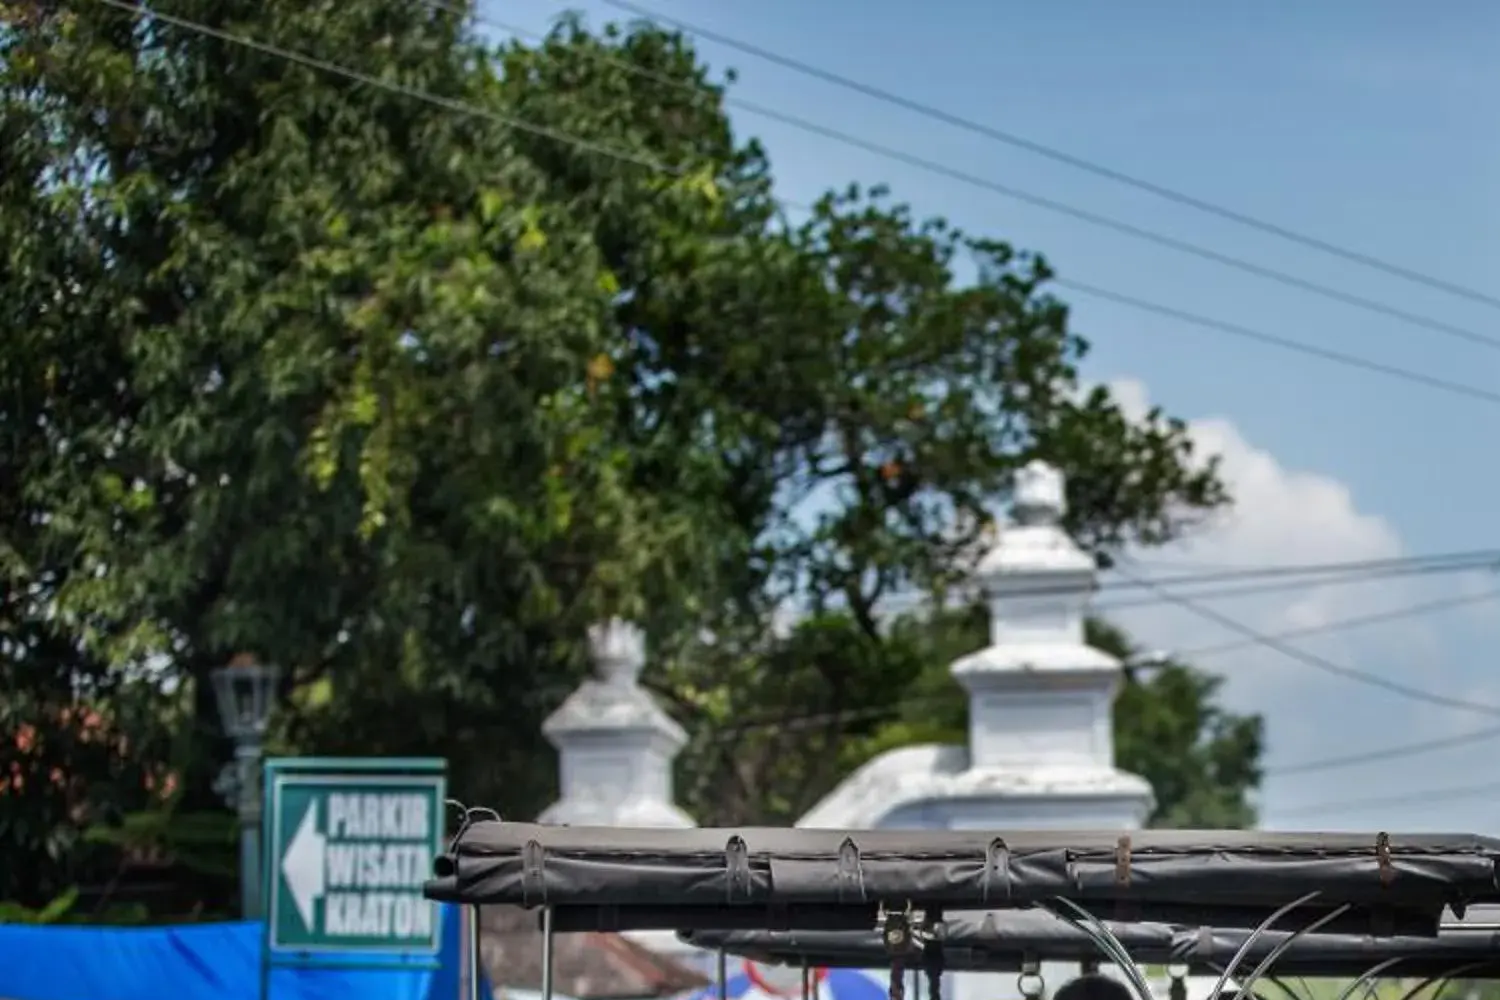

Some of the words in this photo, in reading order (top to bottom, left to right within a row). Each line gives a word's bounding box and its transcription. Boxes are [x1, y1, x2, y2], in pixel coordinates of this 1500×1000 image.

[328, 792, 428, 838] PARKIR
[327, 843, 430, 887] WISATA
[324, 892, 432, 936] KRATON
